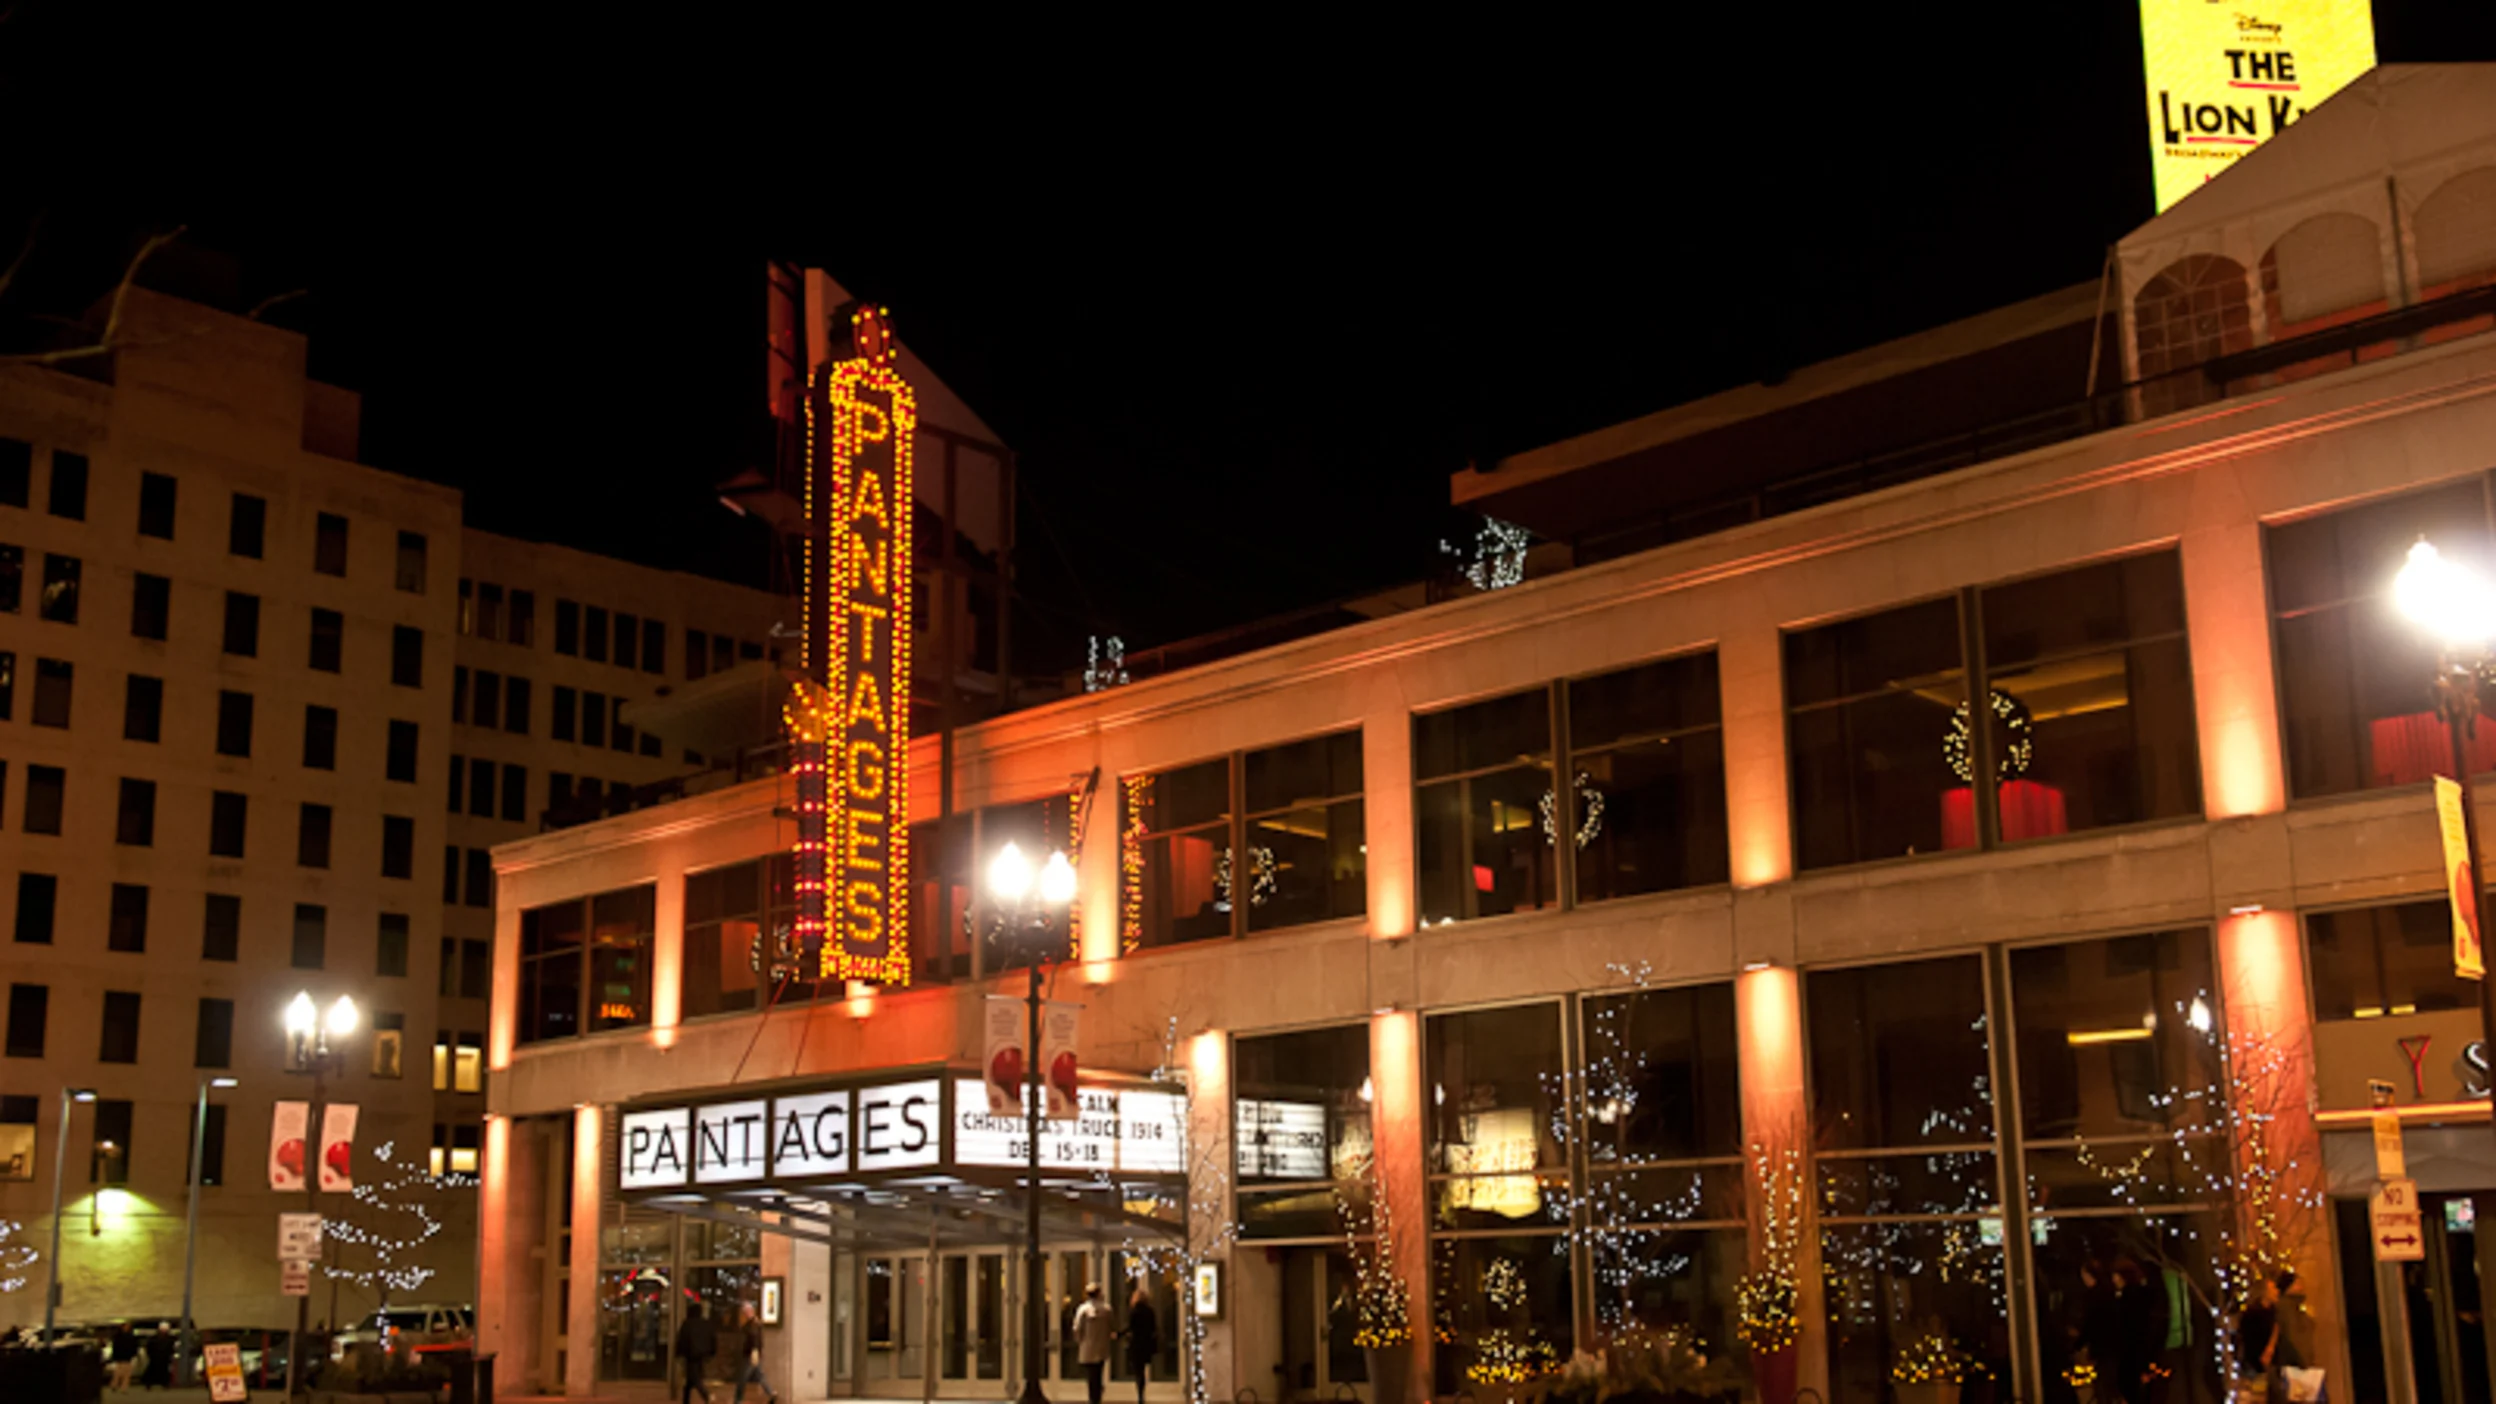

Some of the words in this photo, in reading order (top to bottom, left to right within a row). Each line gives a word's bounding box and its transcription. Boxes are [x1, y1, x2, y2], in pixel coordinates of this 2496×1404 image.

[2224, 49, 2296, 81] THE
[2268, 94, 2306, 136] K
[847, 401, 890, 943] PANTAGES
[628, 1096, 929, 1176] PANTAGES
[1131, 1121, 1162, 1139] 1914
[1009, 1140, 1046, 1158] DE
[2383, 1187, 2404, 1206] NO
